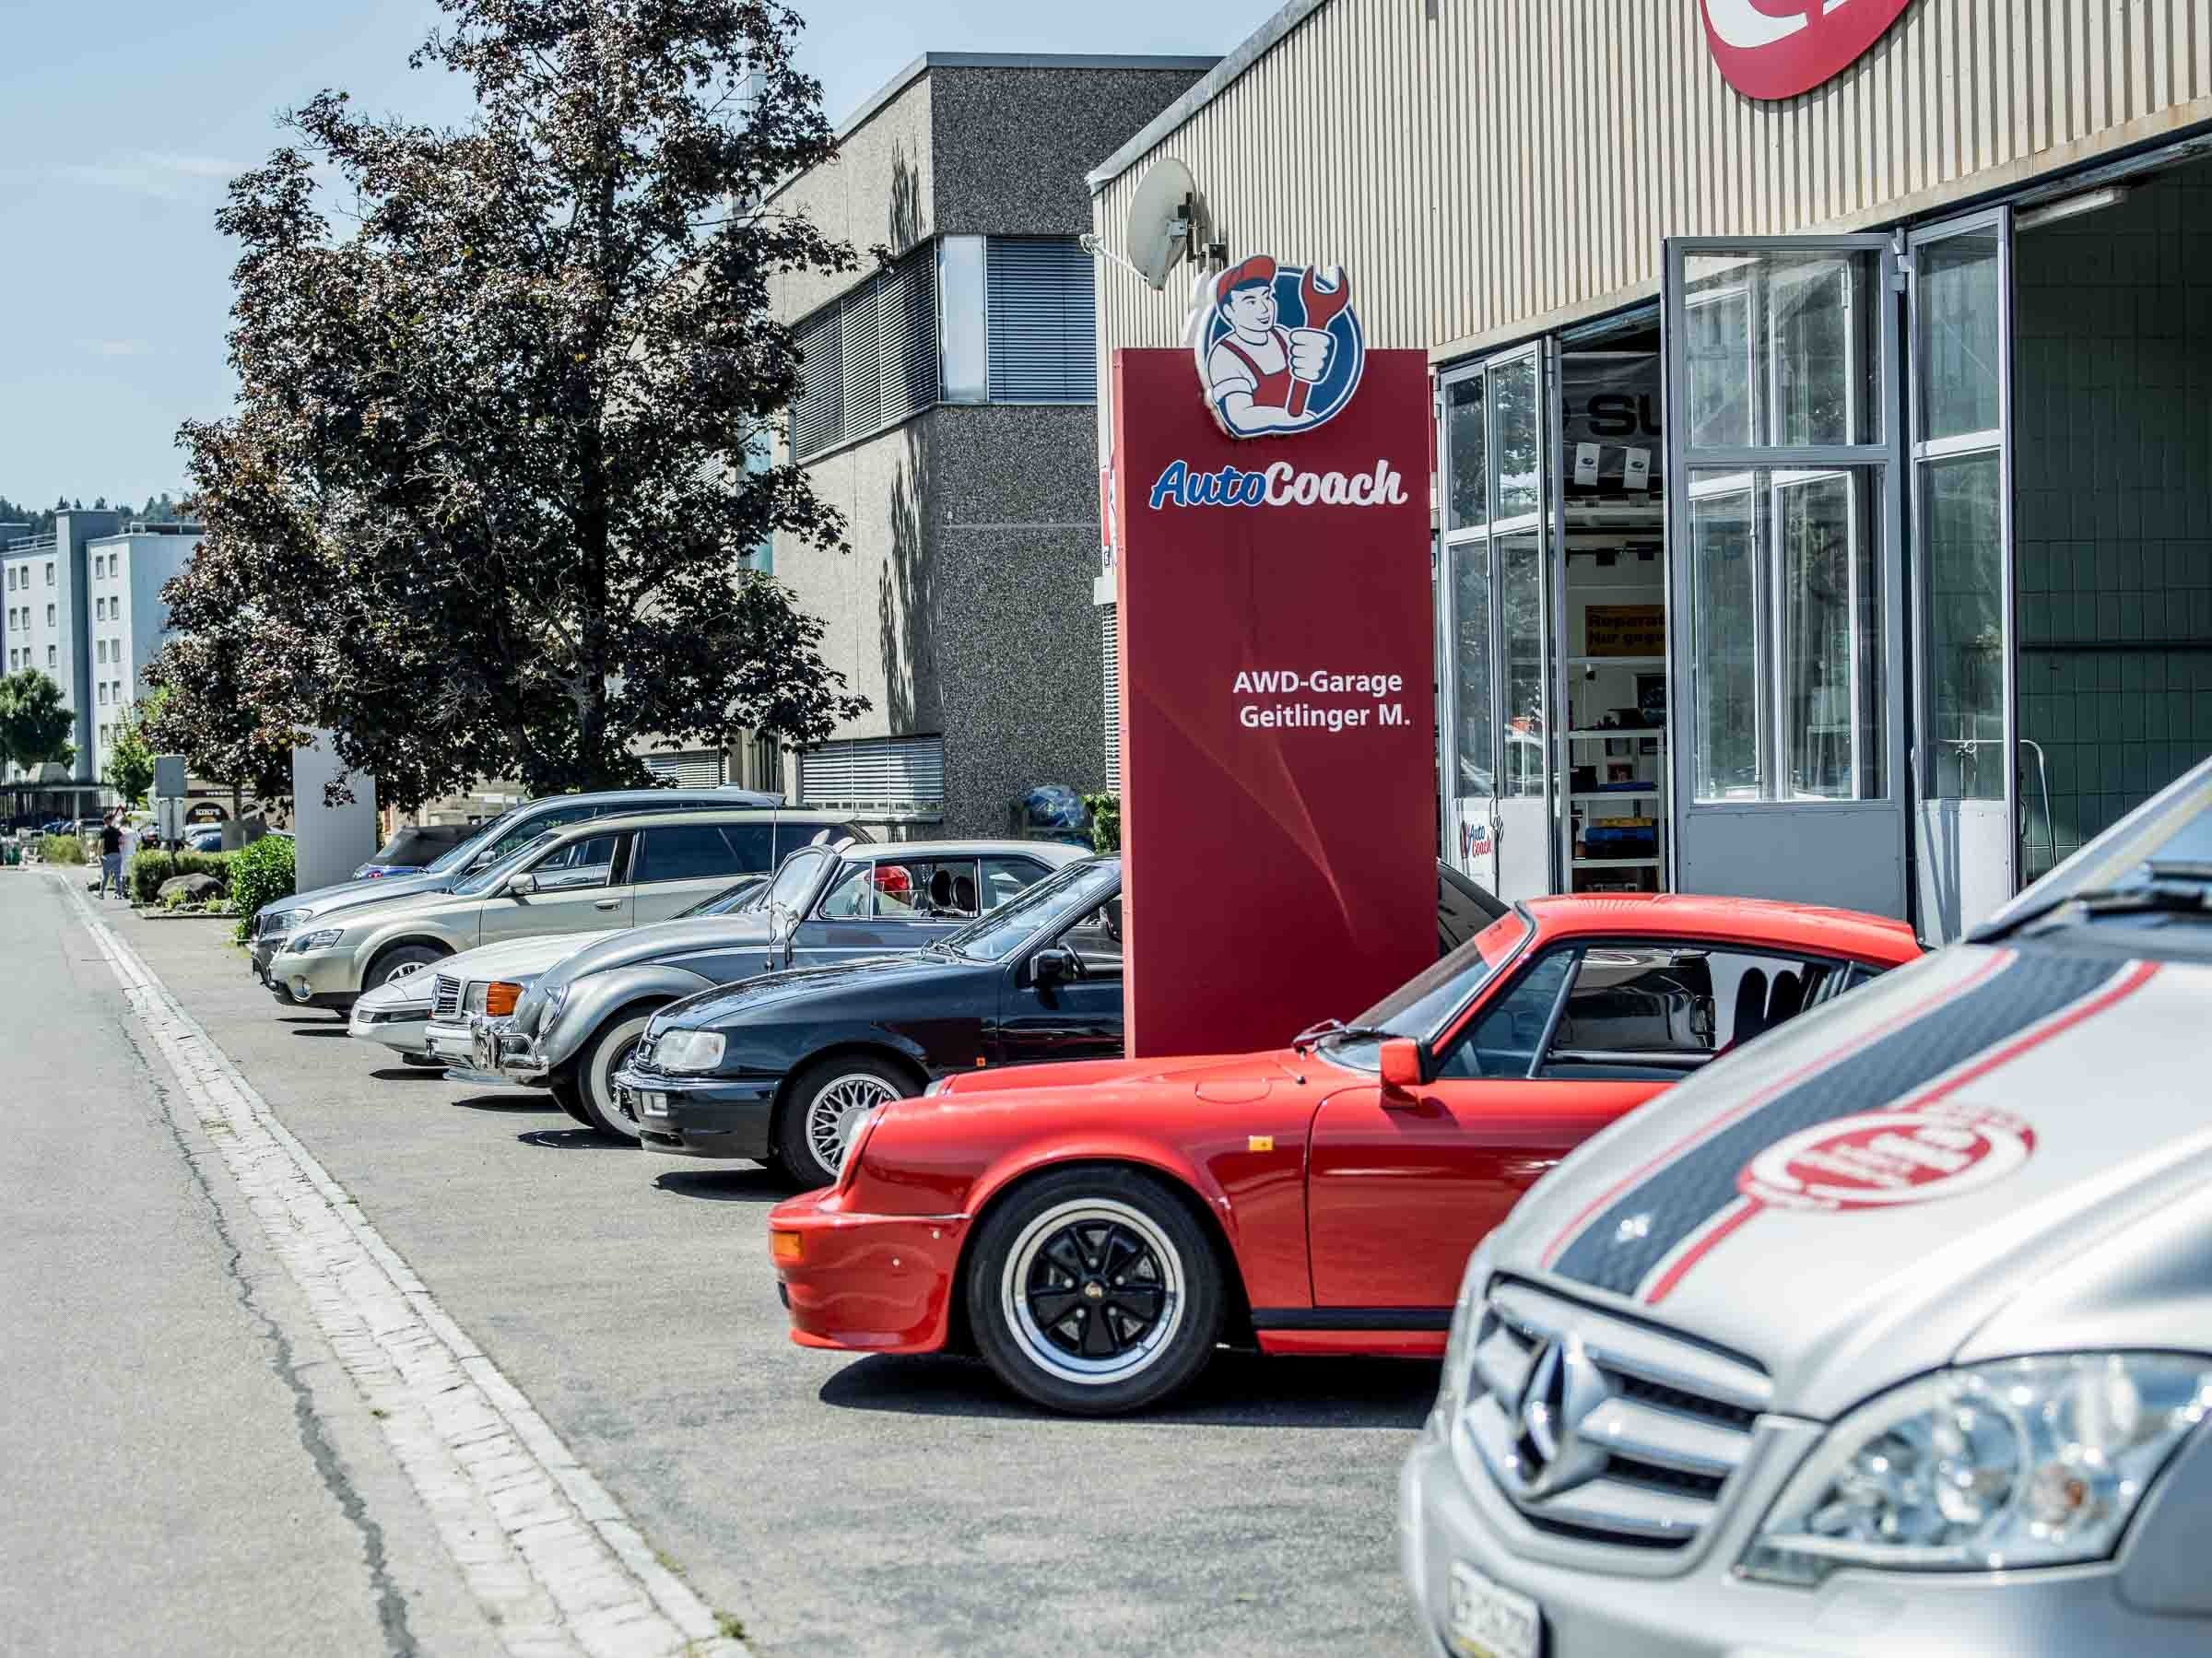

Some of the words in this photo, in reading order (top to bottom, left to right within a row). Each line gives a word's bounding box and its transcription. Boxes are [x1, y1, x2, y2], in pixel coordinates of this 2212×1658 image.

[1149, 459, 1408, 510] AutoCoach
[1233, 670, 1403, 698] AWD-Garage
[1240, 703, 1370, 732] Geitlinger
[1378, 705, 1411, 726] M.
[1468, 823, 1486, 841] Auto
[1472, 834, 1493, 858] Coach
